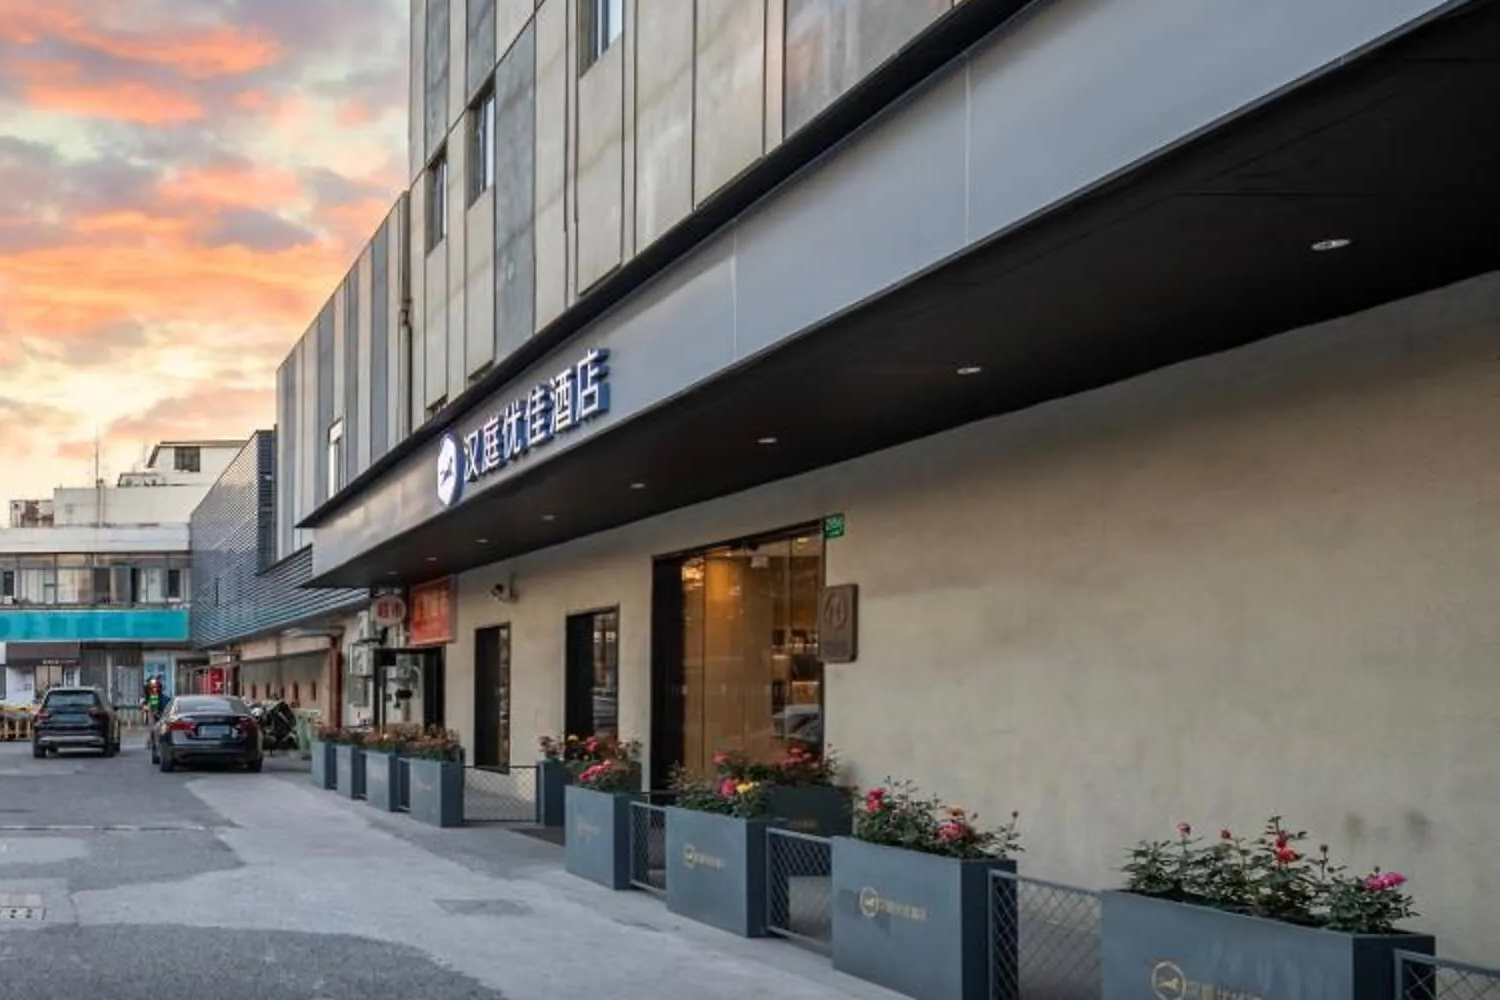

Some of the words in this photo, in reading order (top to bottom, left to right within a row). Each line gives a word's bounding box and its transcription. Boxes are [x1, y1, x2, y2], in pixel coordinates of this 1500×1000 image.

[464, 348, 609, 481] 汉庭优佳酒店
